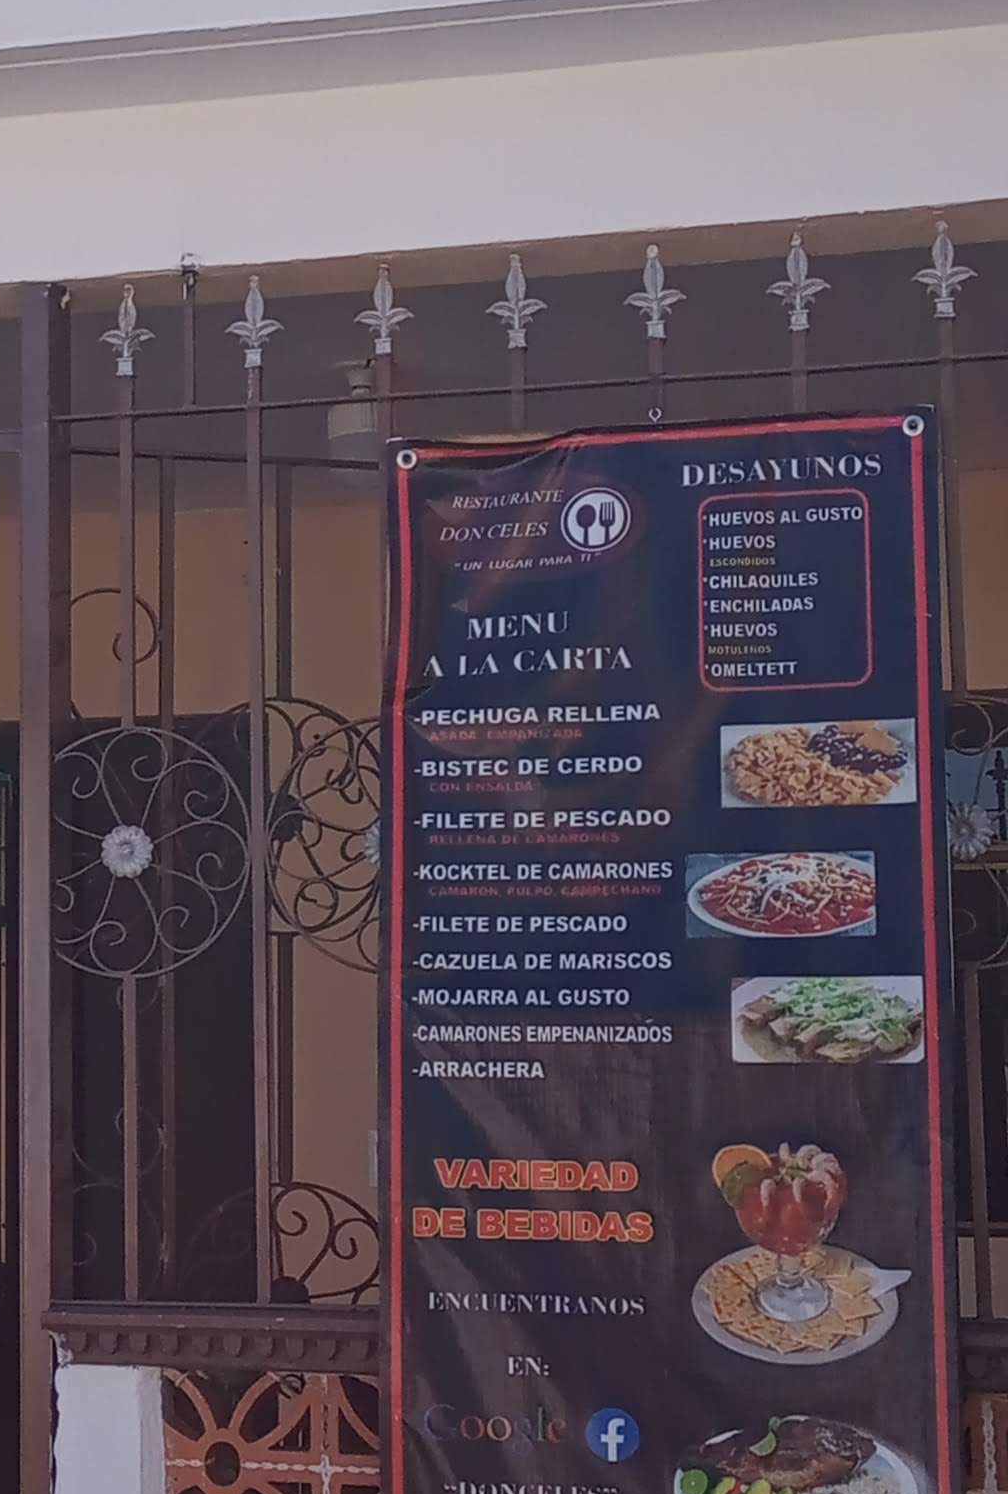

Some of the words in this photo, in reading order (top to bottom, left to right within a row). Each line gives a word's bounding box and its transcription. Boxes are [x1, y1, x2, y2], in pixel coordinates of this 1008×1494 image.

[681, 453, 883, 487] DESAYUNOS
[451, 489, 565, 510] RESTAURANTE
[708, 510, 776, 527] HUEVOS
[780, 509, 801, 524] AL
[805, 506, 864, 523] GUSTO
[439, 526, 485, 542] DON
[487, 520, 550, 540] CELES
[708, 534, 777, 551] HUEVOS
[489, 558, 533, 571] LUGAR
[539, 555, 573, 567] PARA
[709, 557, 776, 568] ESCONDIDOS
[708, 571, 820, 590] CHILAQUILES
[709, 596, 815, 614] ENCHILADAS
[466, 610, 569, 641] MENU
[710, 622, 779, 638] HUEVOS
[423, 655, 444, 677] A
[458, 653, 500, 676] LA
[513, 646, 633, 673] CARTA
[710, 661, 798, 677] OMELTETT
[413, 706, 540, 726] -PECHUGA
[547, 703, 661, 723] RELLENA
[430, 729, 477, 742] ASADA
[413, 758, 510, 777] -BISTEC
[517, 758, 549, 775] DE
[557, 756, 643, 774] CERDO
[430, 782, 460, 792] CON
[413, 811, 506, 830] -FILETE
[513, 811, 545, 829] DE
[553, 808, 672, 827] PESCADO
[413, 863, 511, 881] -KOCKTEL
[516, 863, 542, 881] DE
[548, 861, 673, 880] CAMARONES
[413, 915, 489, 933] -FILETE
[496, 915, 523, 932] DE
[529, 915, 628, 932] PESCADO
[413, 953, 517, 971] -CAZUELA
[524, 953, 552, 970] DE
[411, 989, 519, 1006] -MOJARRA
[524, 989, 552, 1006] AL
[558, 988, 631, 1006] GUSTO
[412, 1025, 522, 1043] -CAMARONES
[526, 1025, 673, 1043] EMPENANIZADOS
[412, 1061, 545, 1079] -ARRACHERA
[434, 1158, 640, 1192] VARIEDAD
[412, 1207, 467, 1239] DE
[477, 1209, 654, 1243] BEBIDAS
[428, 1291, 645, 1316] ENCUENTRANOS
[507, 1356, 550, 1377] EN:
